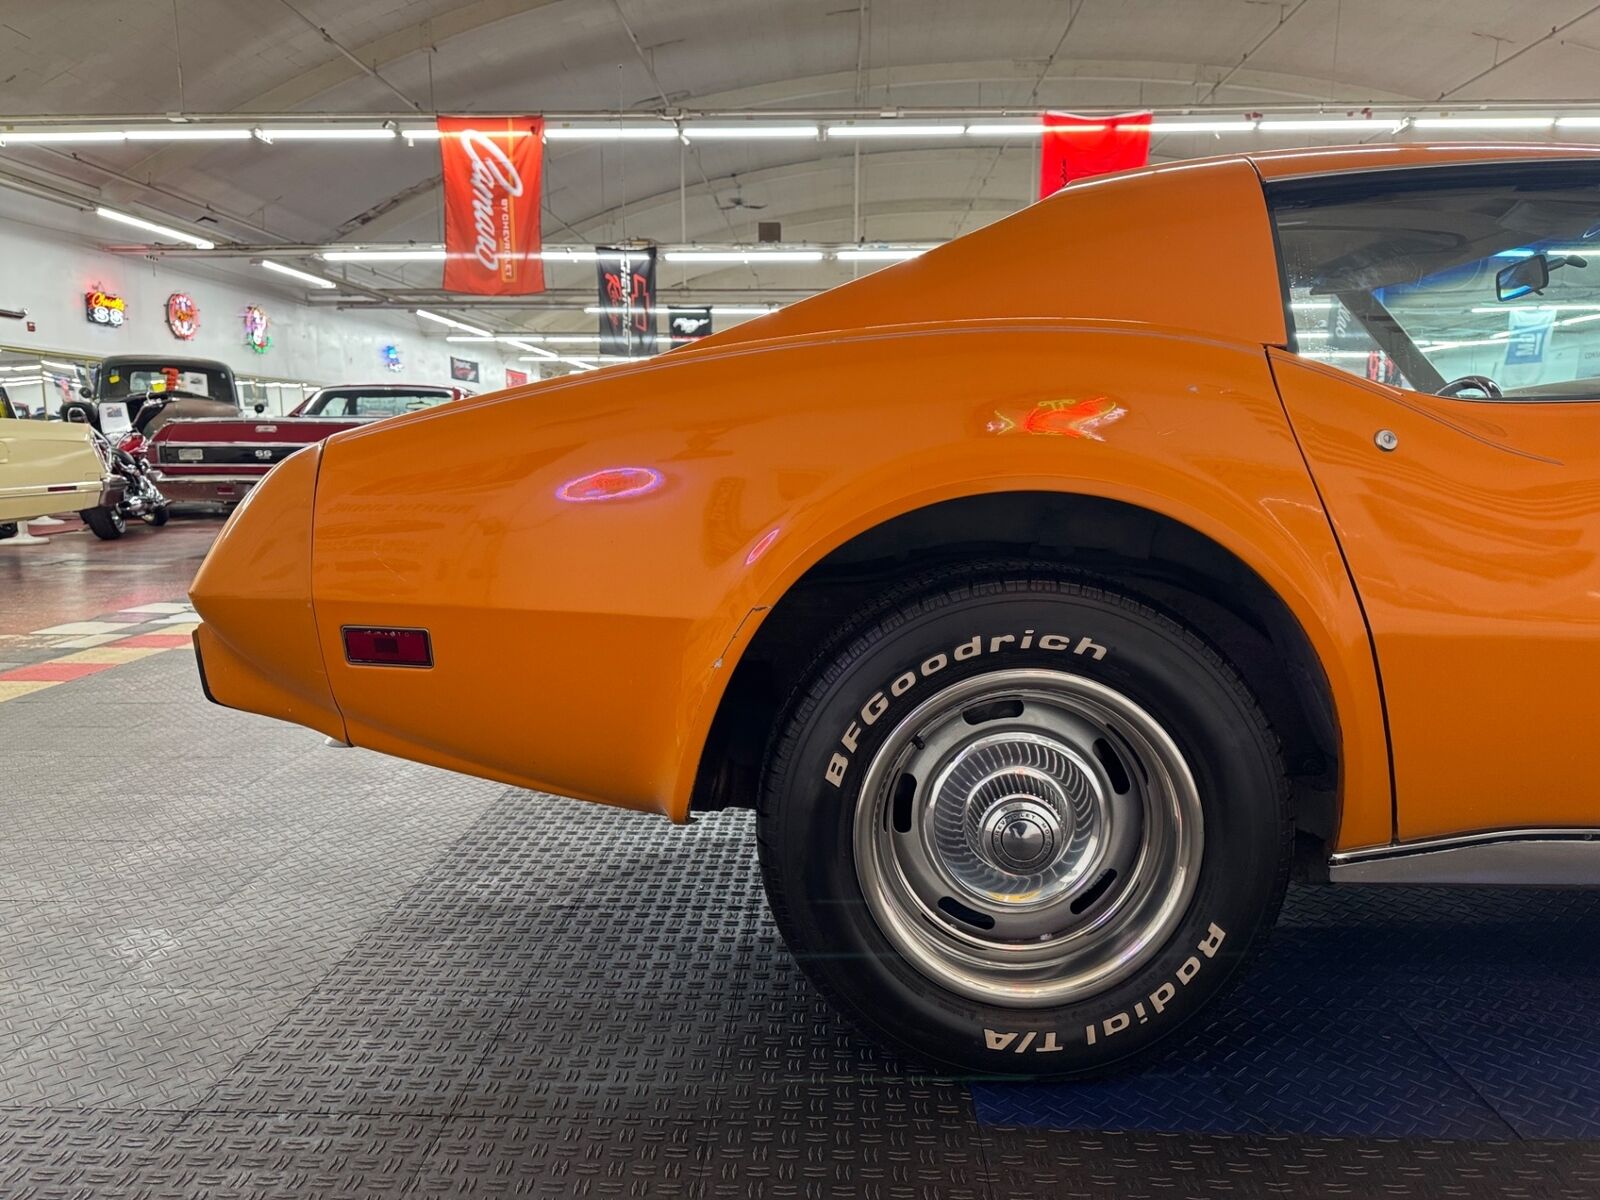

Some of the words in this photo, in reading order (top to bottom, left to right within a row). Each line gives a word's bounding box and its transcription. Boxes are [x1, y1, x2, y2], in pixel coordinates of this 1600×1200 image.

[460, 129, 524, 271] Camaro
[501, 199, 508, 214] BY
[502, 214, 512, 277] CHEVROLET
[93, 306, 124, 325] SS
[254, 449, 273, 458] SS
[824, 629, 1108, 788] BFGoodrich
[994, 813, 1036, 842] CHEVROLET
[1086, 922, 1227, 1045] Radial
[983, 1028, 1064, 1053] T/A
